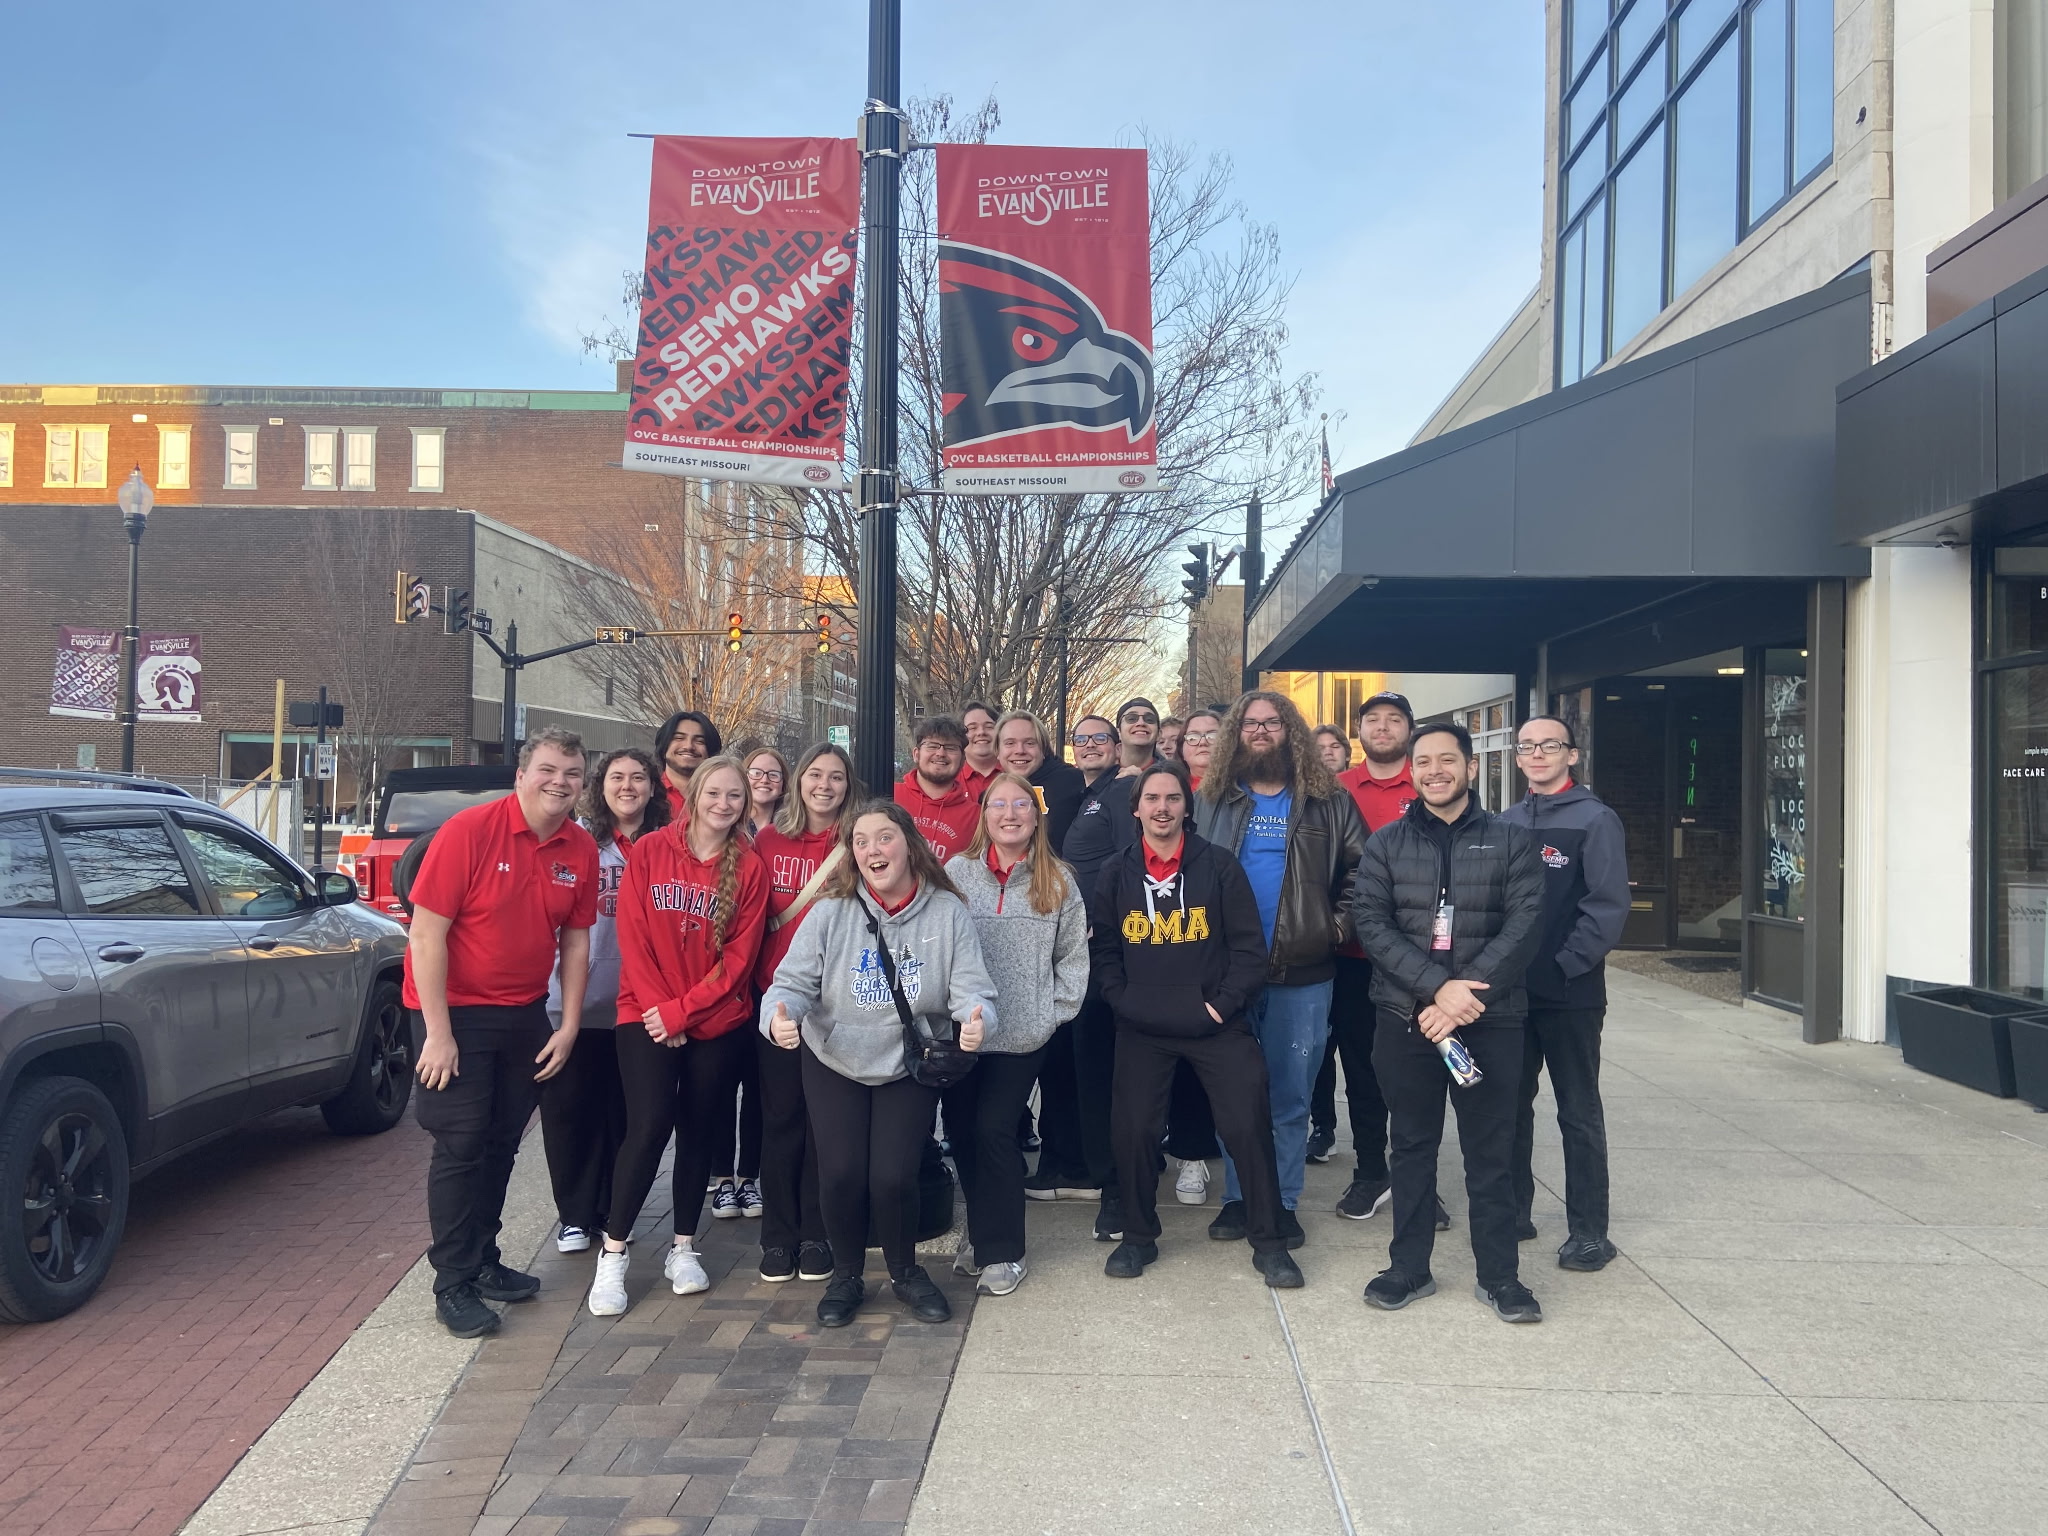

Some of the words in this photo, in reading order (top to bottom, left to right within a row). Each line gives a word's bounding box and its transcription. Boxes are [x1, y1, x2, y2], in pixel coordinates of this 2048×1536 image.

[692, 156, 820, 178] DOWNTOWN
[978, 168, 1108, 188] DOWNTOWN
[691, 172, 820, 215] EVANSVILLE
[978, 184, 1108, 226] EVANSVILLE
[653, 246, 851, 422] REDHAWKS
[659, 284, 760, 371] SEMO
[634, 430, 659, 441] OVC
[662, 434, 738, 448] BASKETBALL
[741, 440, 837, 457] CHAMPIONSHIPS
[635, 452, 698, 466] SOUTHEAST
[701, 459, 750, 472] MISSOURI
[950, 454, 974, 463] OVC
[978, 453, 1052, 463] BASKETBALL
[1055, 451, 1149, 462] CHAMPIONSHIPS
[808, 470, 825, 478] OVC
[955, 477, 1015, 486] SOUTHEAST
[1018, 477, 1067, 486] MISSOURI
[71, 637, 112, 649] EVANSVILLE
[618, 631, 629, 641] St
[150, 641, 190, 653] EVANSVILLE
[1782, 735, 1805, 749] LOC
[320, 746, 332, 756] ONE
[320, 756, 331, 765] WAY
[1774, 754, 1806, 769] FLOW
[2003, 768, 2022, 778] FACE
[2024, 767, 2046, 777] CARE
[1782, 799, 1805, 814] LOC
[1791, 818, 1805, 832] JO
[1545, 855, 1569, 865] SEMO
[773, 854, 815, 887] SEMO
[852, 975, 891, 994] CROS
